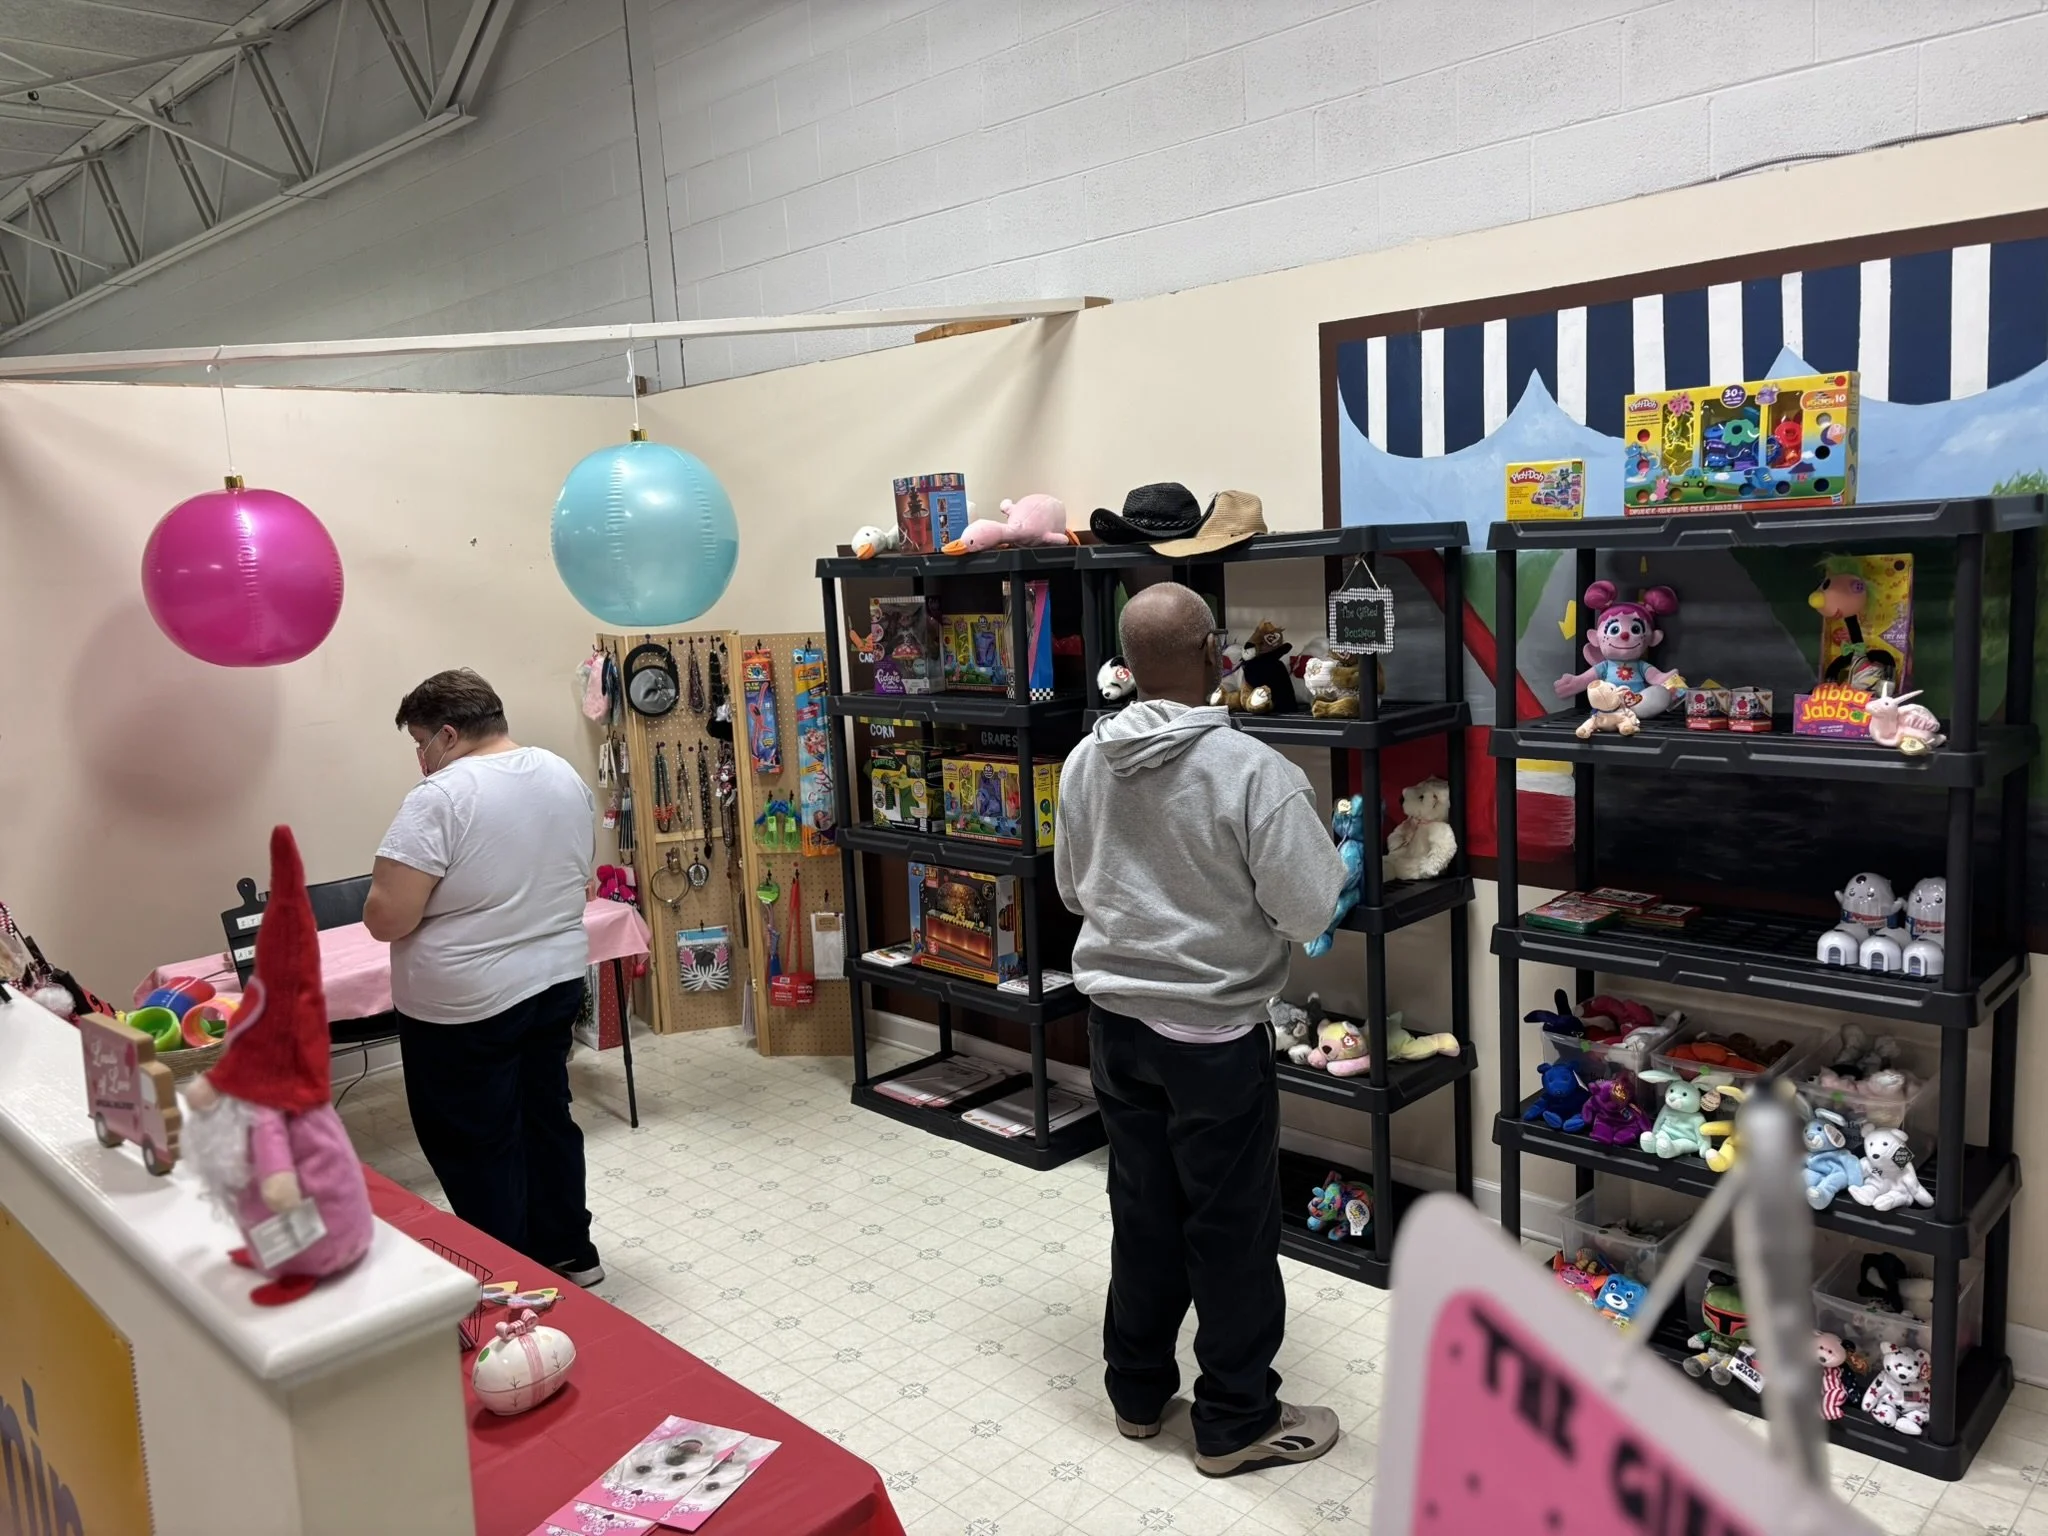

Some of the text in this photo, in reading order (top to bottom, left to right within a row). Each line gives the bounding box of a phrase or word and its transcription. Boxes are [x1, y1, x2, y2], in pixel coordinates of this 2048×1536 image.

[1724, 388, 1744, 398] 30+
[1834, 395, 1846, 404] 10
[1511, 469, 1544, 482] Play-Doh
[1883, 633, 1895, 641] TRY
[1811, 685, 1867, 704] Jibba
[870, 723, 895, 739] CORN
[981, 731, 1018, 747] GRAPES
[1871, 1167, 1883, 1177] 24
[1469, 1306, 1576, 1463] THE
